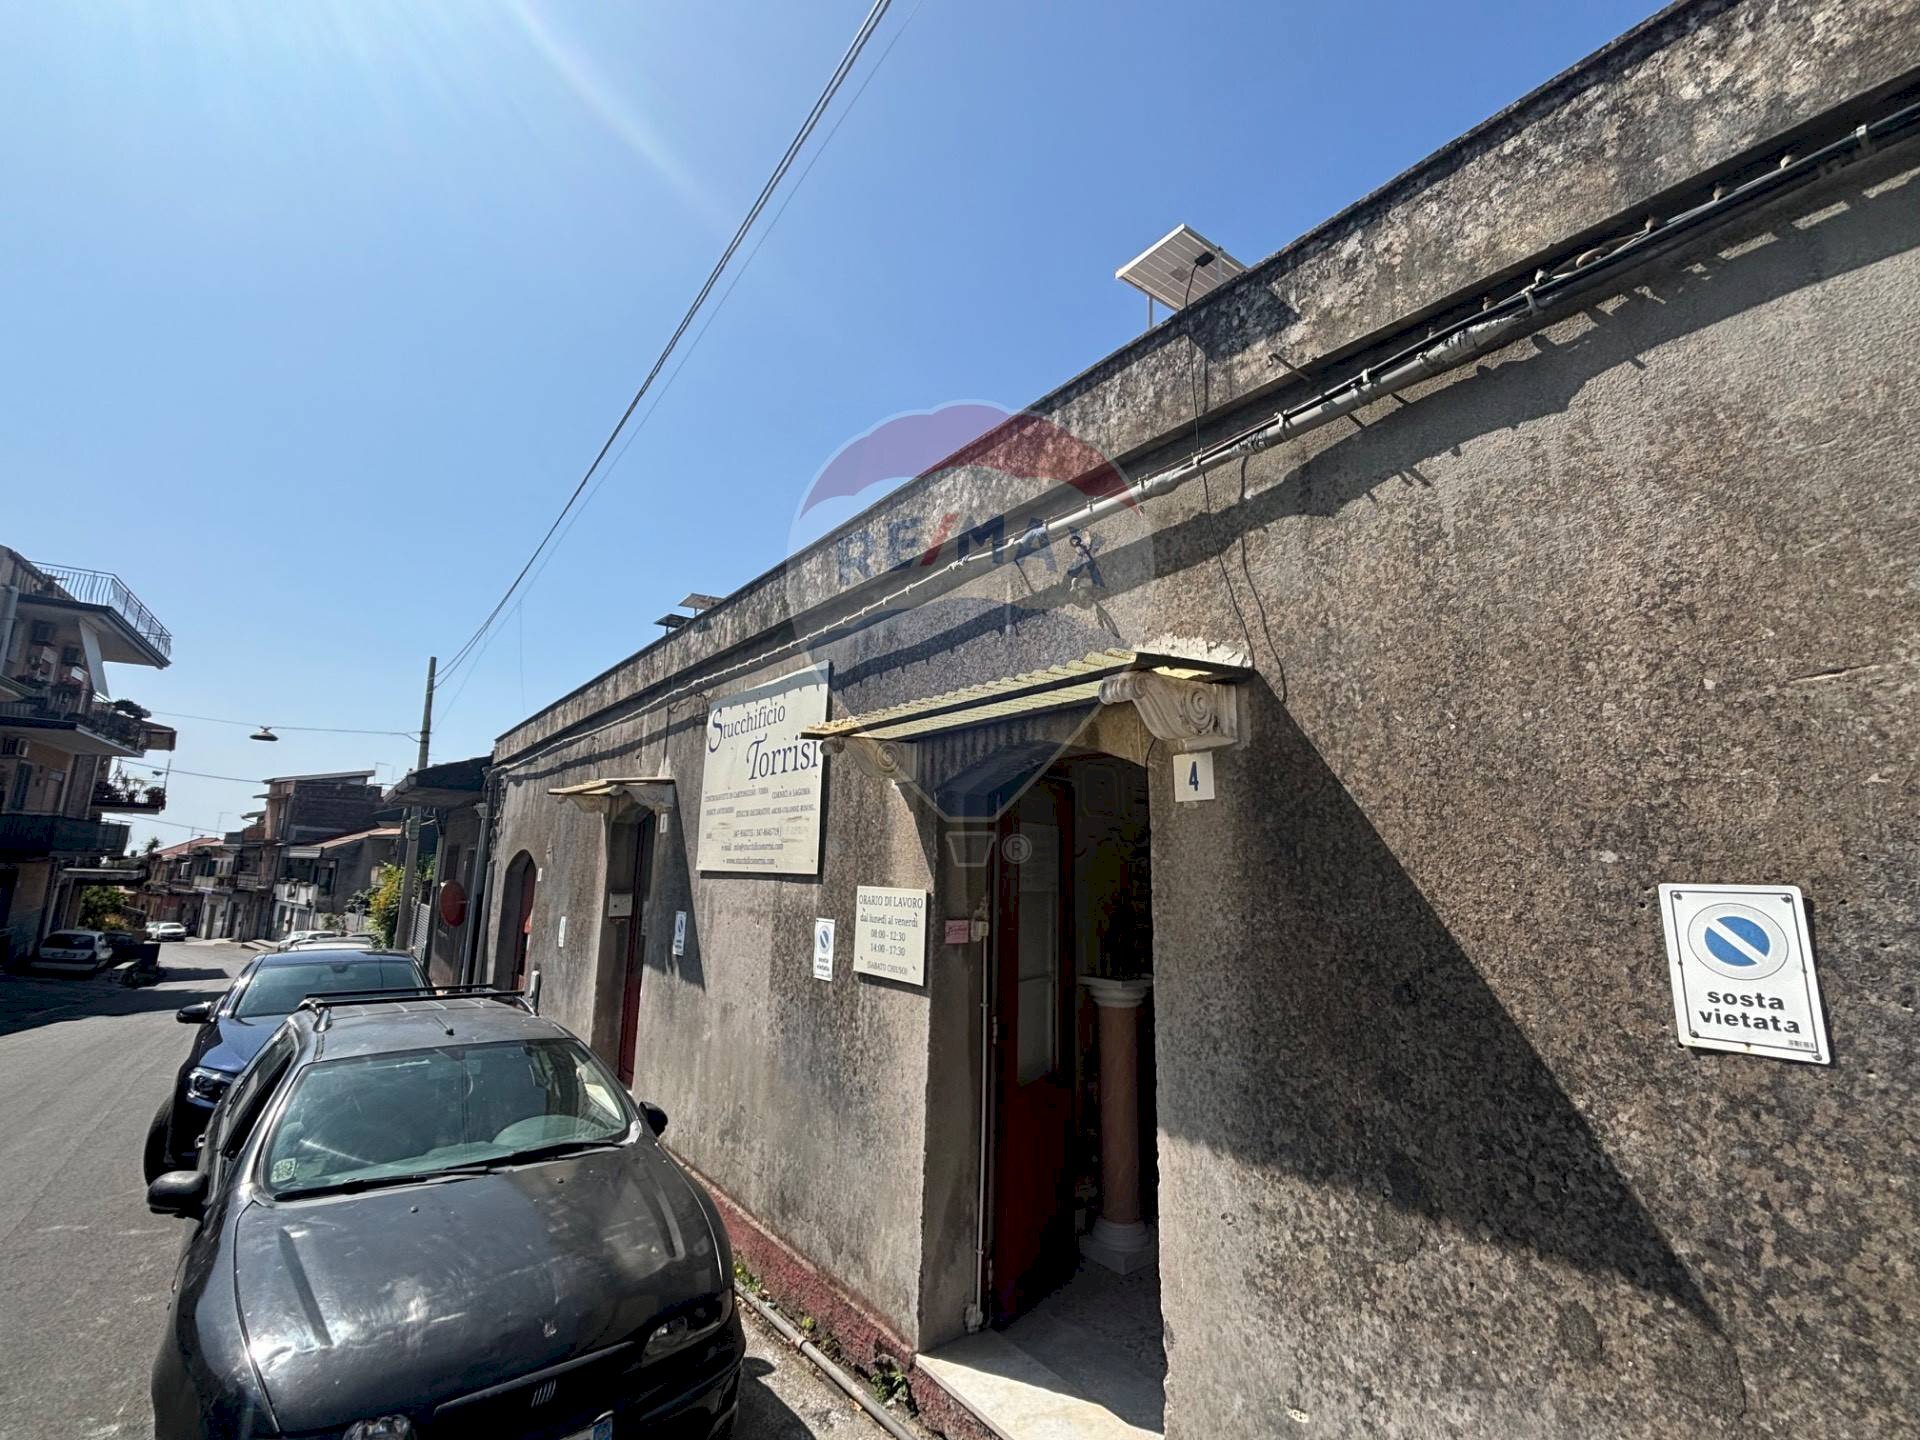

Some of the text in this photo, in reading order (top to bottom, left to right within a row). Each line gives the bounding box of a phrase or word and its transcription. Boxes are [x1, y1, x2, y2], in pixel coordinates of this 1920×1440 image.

[708, 702, 786, 753] Stucchificio
[746, 733, 818, 780] Torrisi
[1189, 760, 1199, 791] 4
[859, 894, 923, 909] ORARIO DI LAVORO
[890, 931, 906, 942] 12:30
[1707, 990, 1785, 1011] sosta
[1699, 1008, 1800, 1034] vietata
